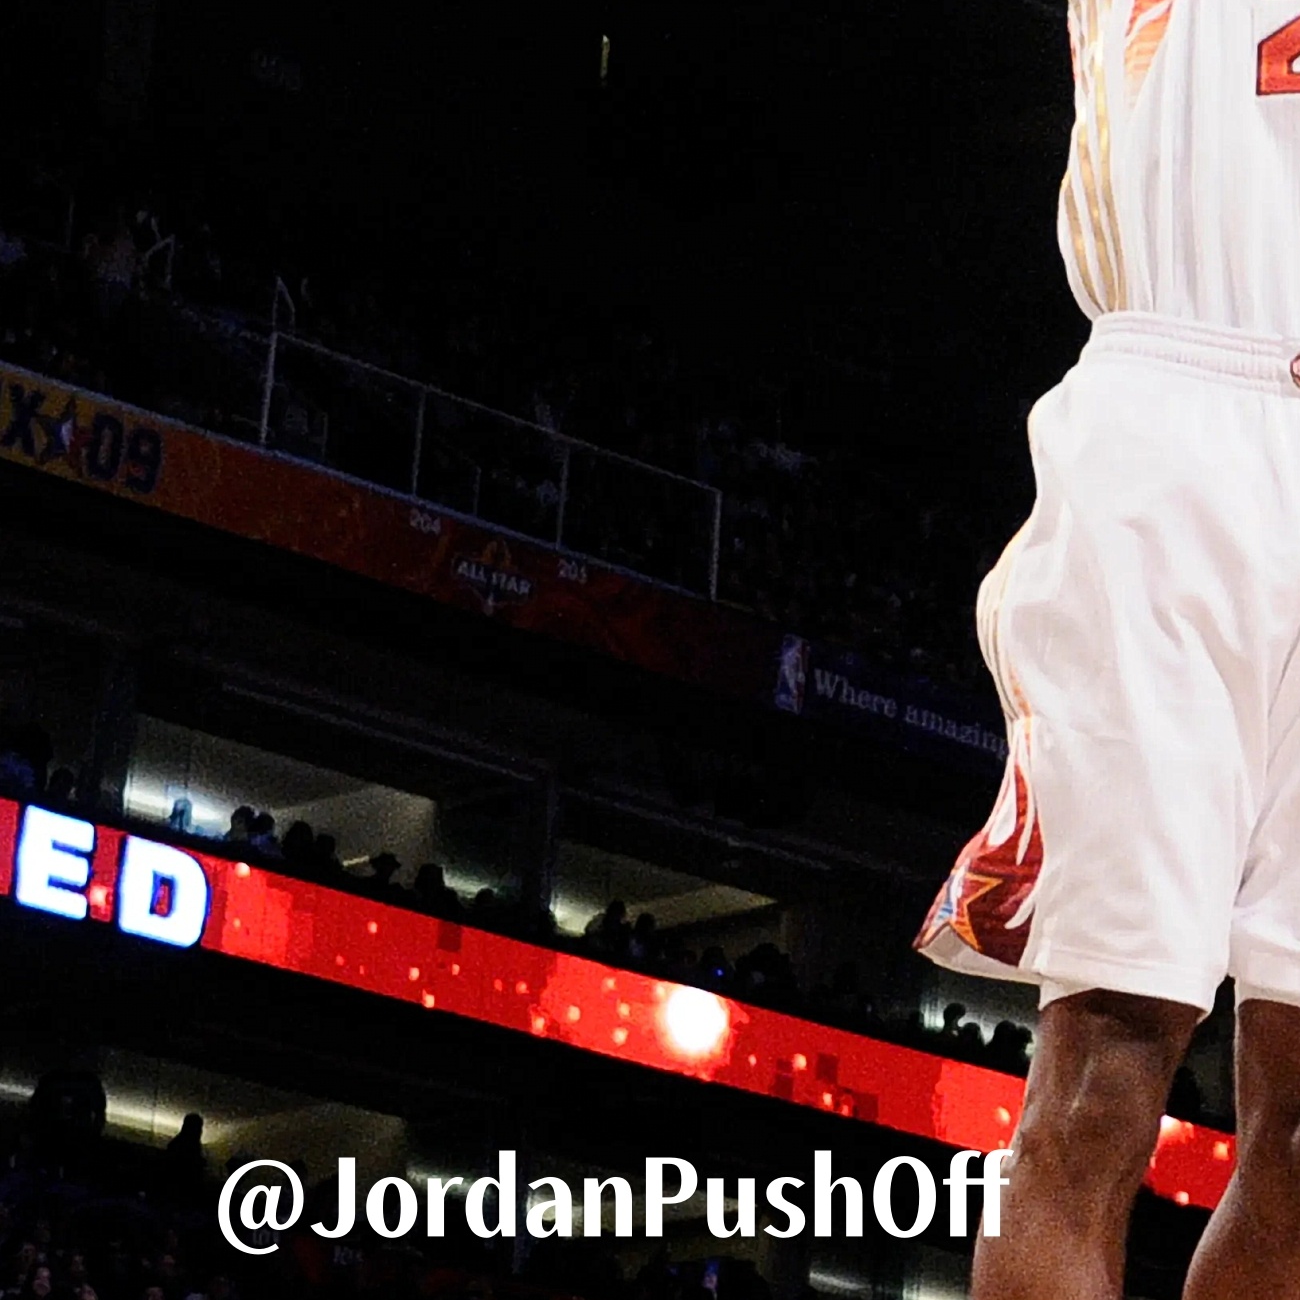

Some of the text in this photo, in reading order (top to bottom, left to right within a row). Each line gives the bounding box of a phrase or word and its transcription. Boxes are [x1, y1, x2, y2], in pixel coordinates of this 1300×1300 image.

[87, 414, 162, 493] 09
[814, 668, 898, 719] Where
[15, 803, 210, 949] ED
